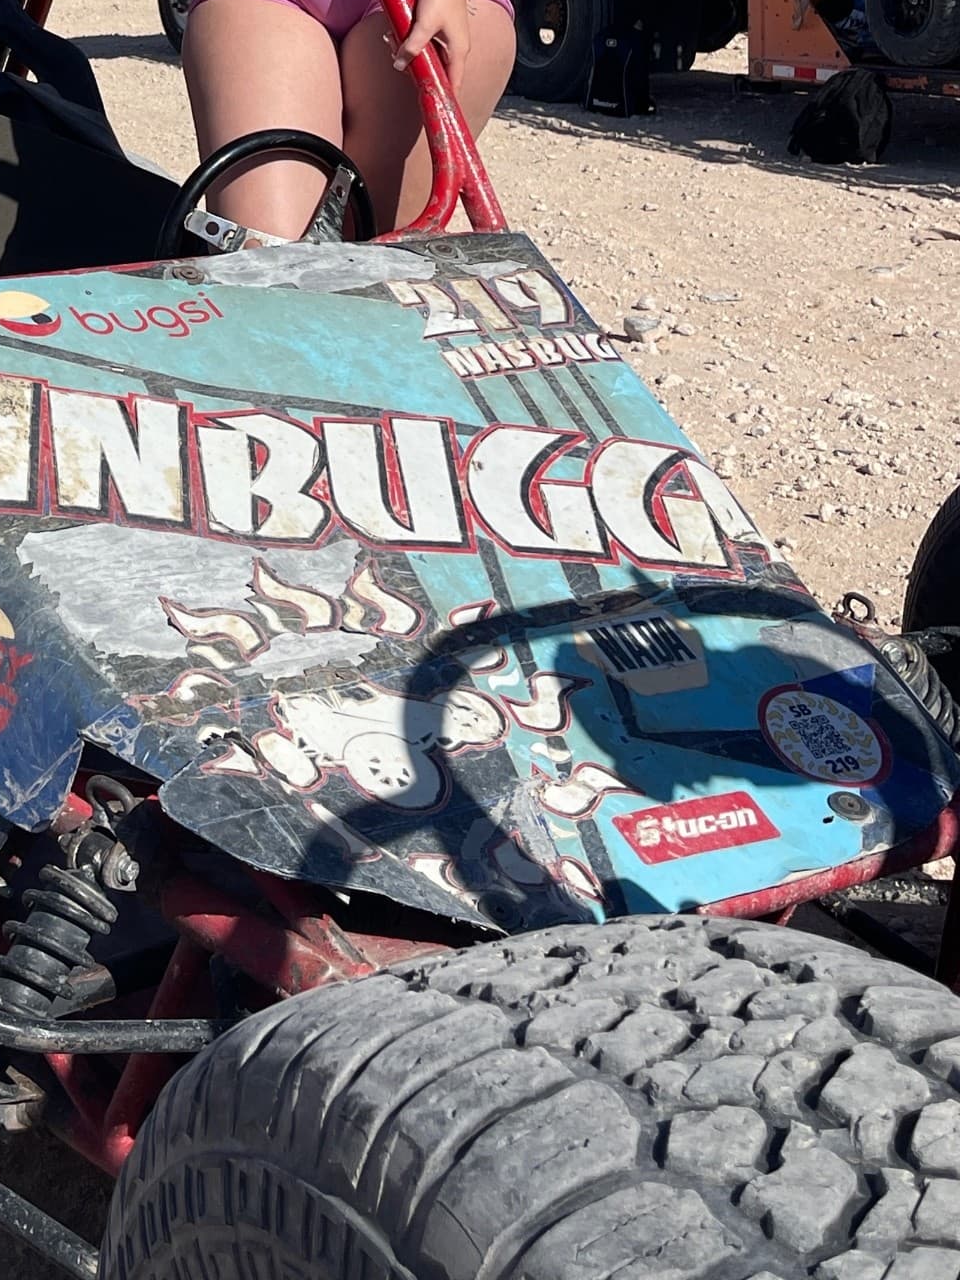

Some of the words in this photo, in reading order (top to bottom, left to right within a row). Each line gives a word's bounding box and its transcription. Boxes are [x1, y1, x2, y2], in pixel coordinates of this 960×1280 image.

[69, 292, 225, 338] bugsi
[386, 269, 574, 340] 219
[825, 755, 860, 774] 219
